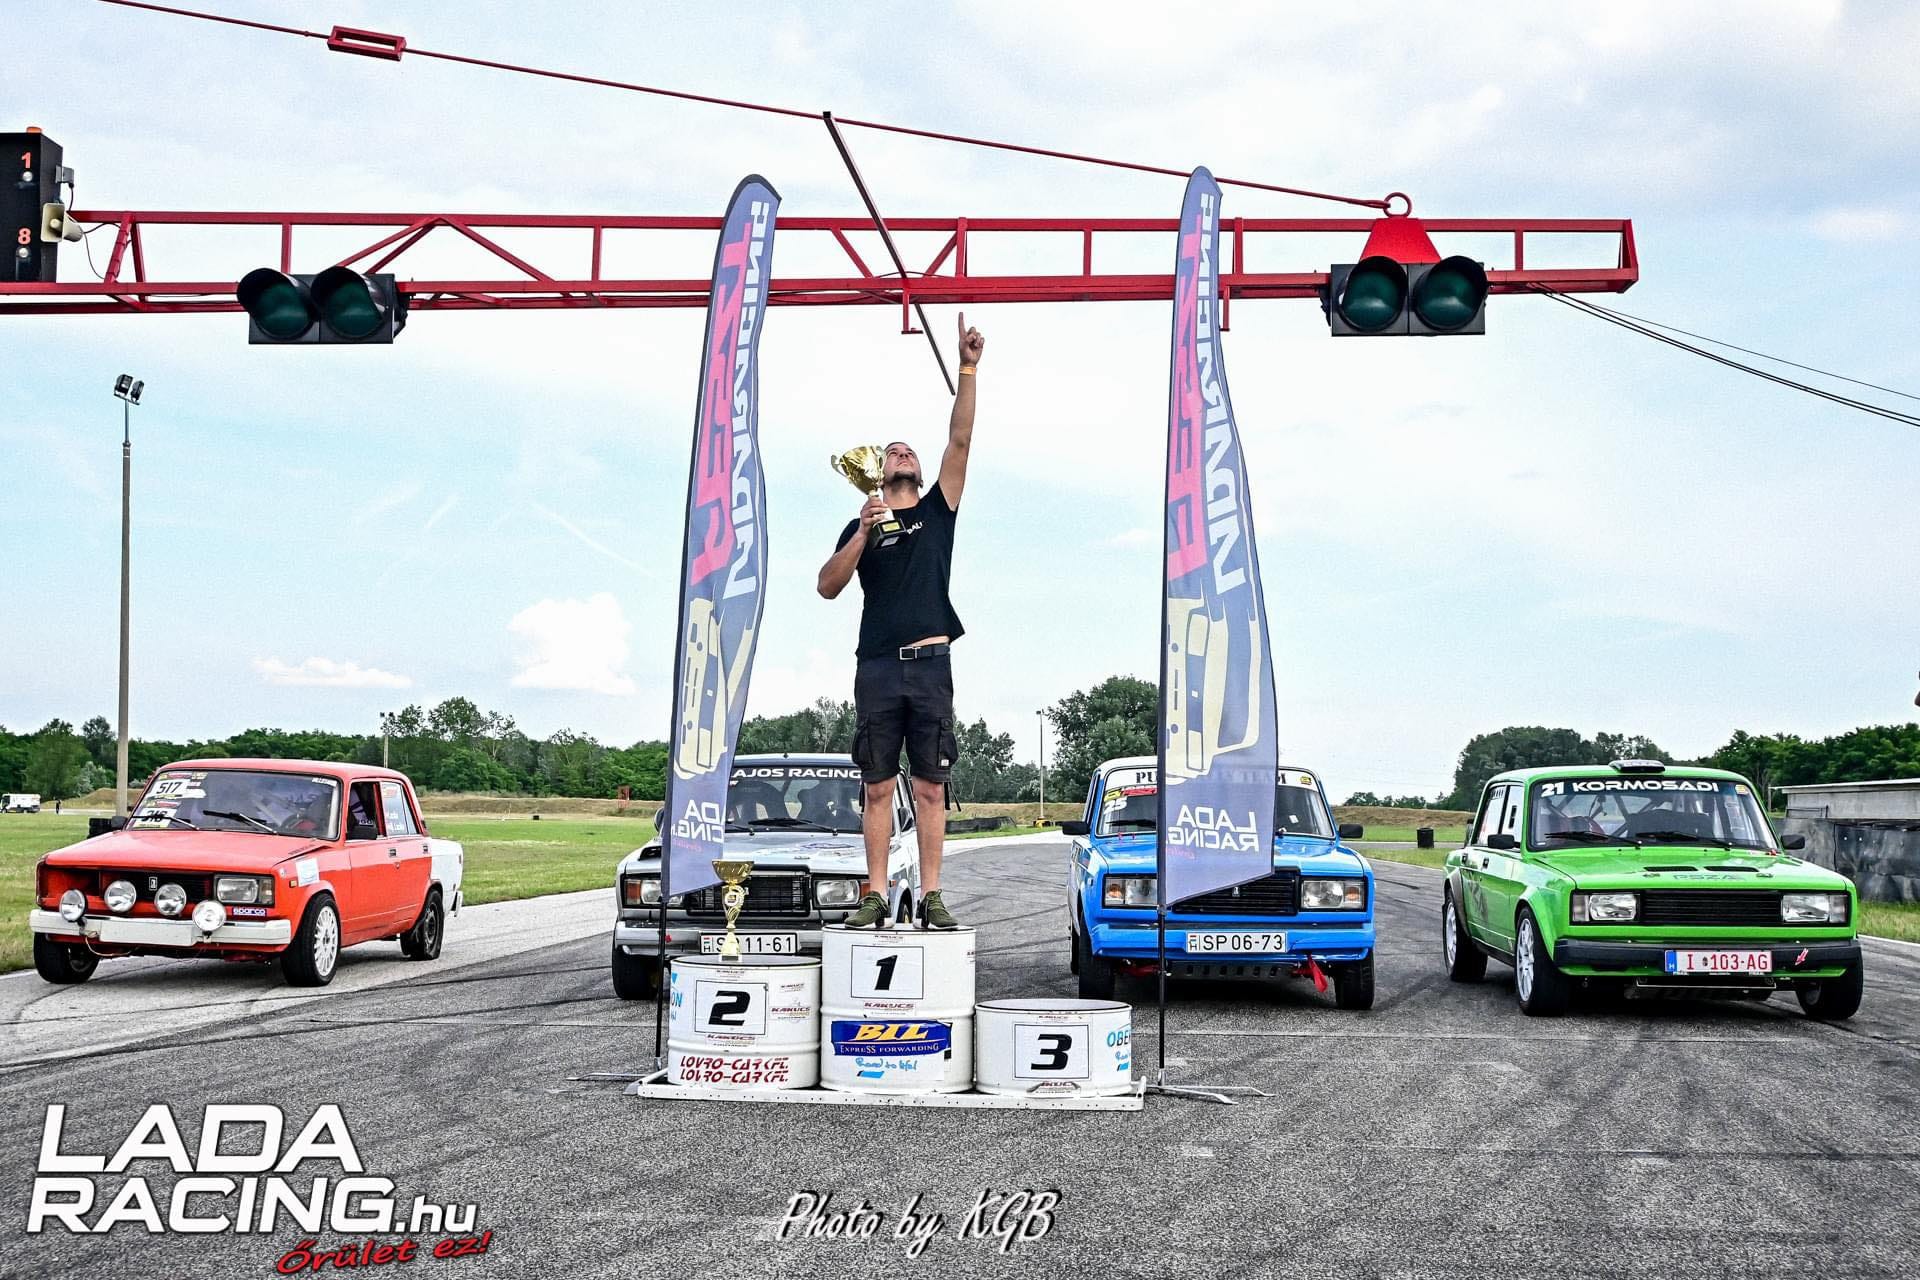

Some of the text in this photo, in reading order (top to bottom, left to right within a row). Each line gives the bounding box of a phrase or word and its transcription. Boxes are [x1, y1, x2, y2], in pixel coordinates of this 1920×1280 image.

[21, 152, 32, 169] 1
[17, 228, 31, 245] 8
[731, 768, 862, 779] AJOS RACING
[156, 782, 182, 794] 517
[1541, 781, 1565, 798] 21
[1572, 780, 1719, 792] KORMOSADI
[745, 936, 791, 953] 11-61
[1203, 935, 1228, 951] SP
[1231, 935, 1283, 951] 06-73
[1710, 954, 1768, 970] 103-AG
[875, 955, 898, 990] 1
[708, 990, 751, 1026] 2
[855, 1023, 928, 1041] BIL
[1107, 1030, 1131, 1047] OBE
[1031, 1034, 1073, 1071] 3
